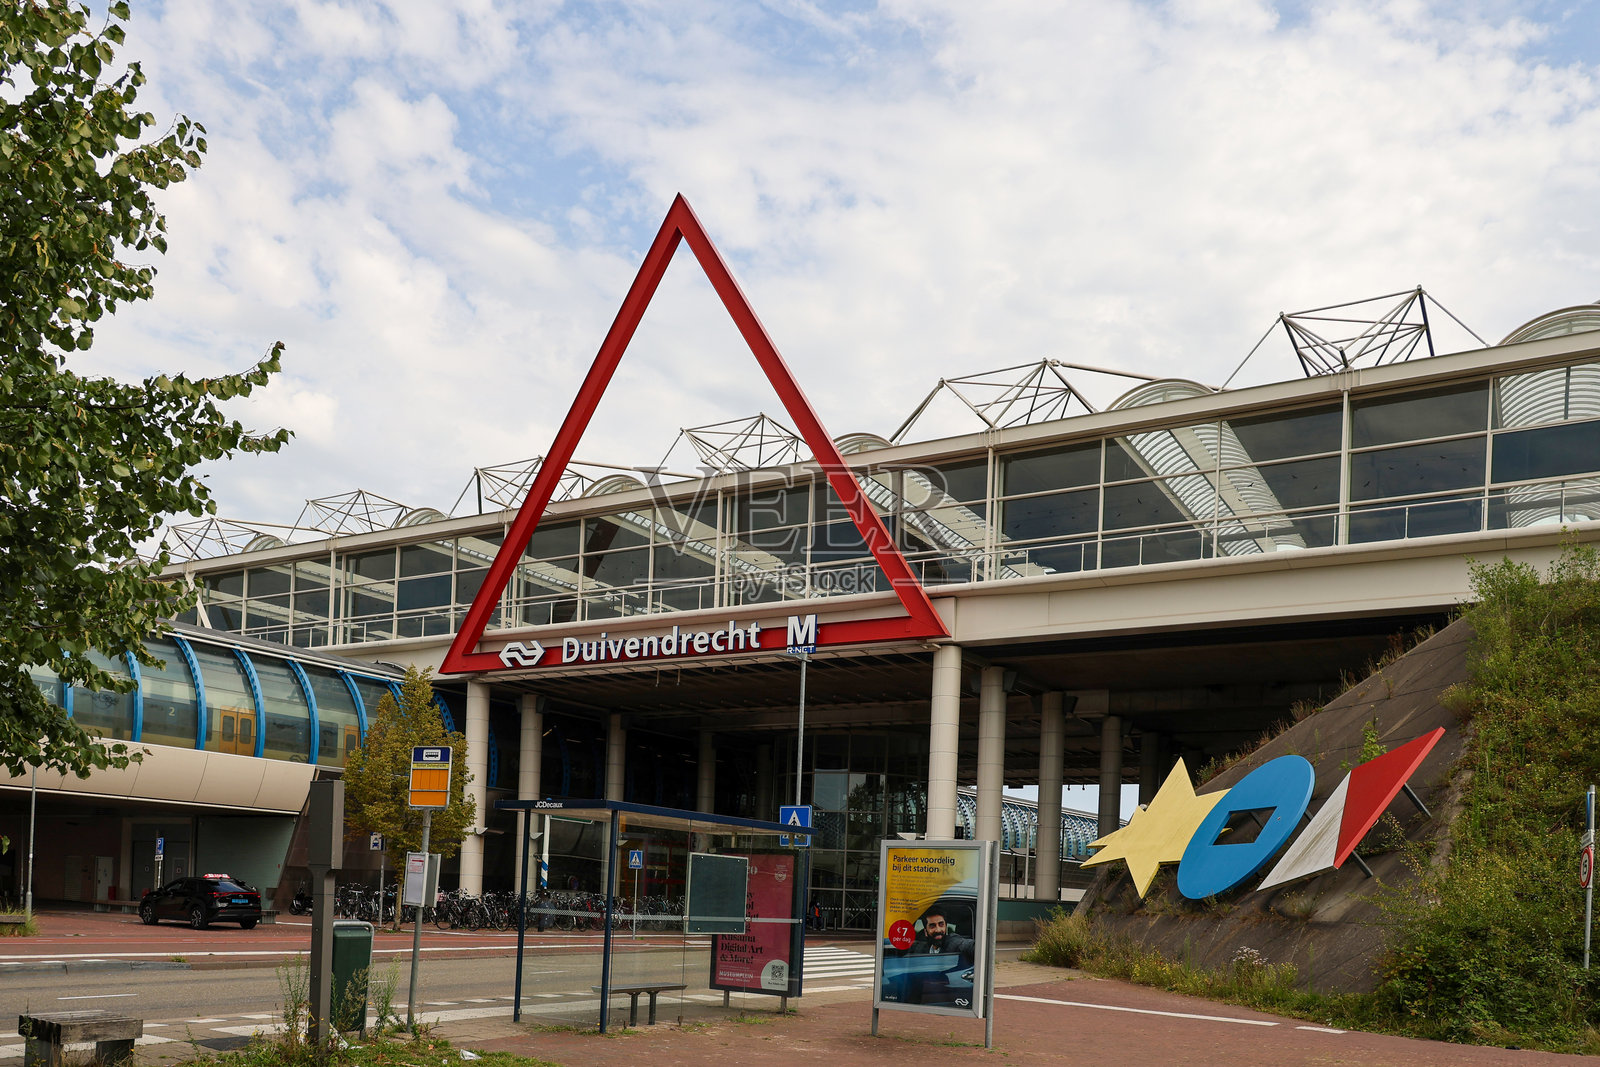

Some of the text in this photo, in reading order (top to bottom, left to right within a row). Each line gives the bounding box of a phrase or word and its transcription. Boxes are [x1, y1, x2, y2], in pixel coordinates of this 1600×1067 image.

[787, 614, 817, 646] M
[562, 620, 761, 663] Duivendrecht
[168, 706, 176, 717] 2
[534, 800, 563, 809] JCDecaux
[893, 854, 955, 866] Parkeer voordelig
[892, 864, 902, 873] bij
[903, 864, 912, 872] dit
[913, 865, 940, 873] station
[721, 943, 763, 954] Digital Art
[720, 953, 728, 962] &
